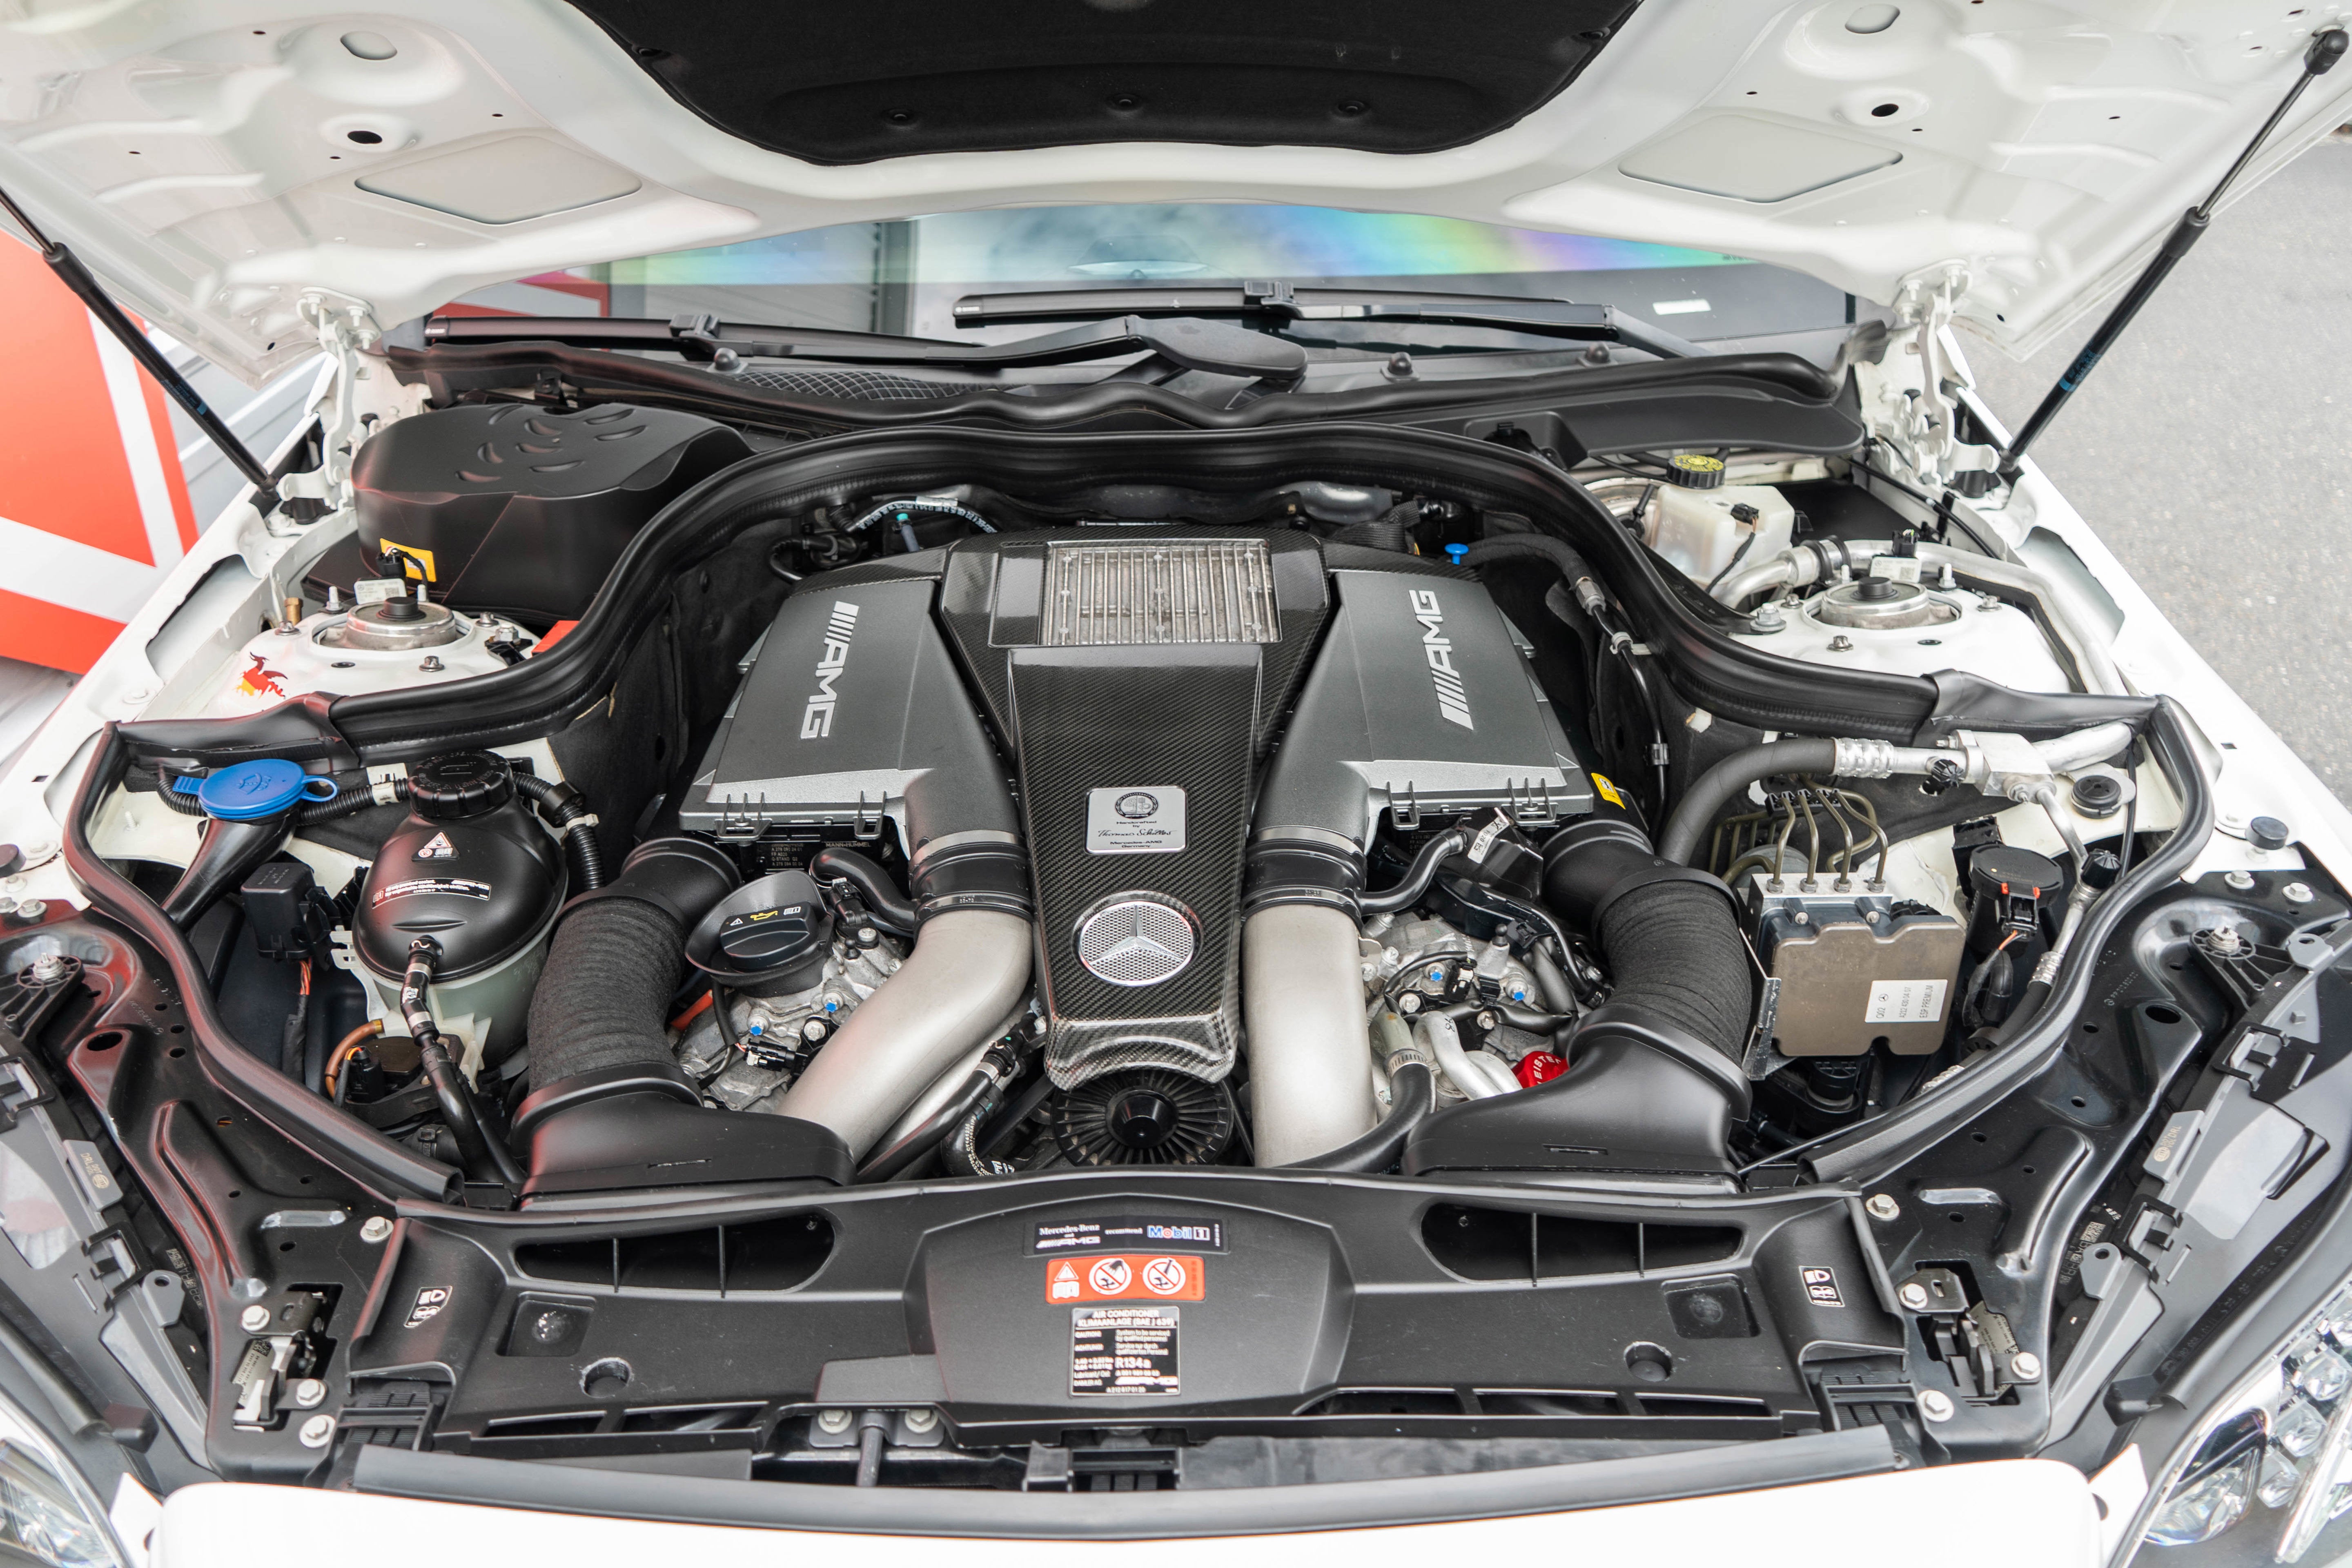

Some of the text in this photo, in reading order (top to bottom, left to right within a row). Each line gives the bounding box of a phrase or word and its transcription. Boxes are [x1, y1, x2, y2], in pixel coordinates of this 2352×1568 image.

[1409, 590, 1462, 686] AMG
[800, 635, 851, 739] AMG
[1922, 984, 1933, 1008] PREMIUM
[80, 1152, 94, 1166] DRL
[1039, 1224, 1100, 1235] Mercedes-Benz
[1147, 1225, 1192, 1239] Mobil
[1056, 1236, 1100, 1247] AMG
[1092, 1310, 1160, 1319] AIR CONDITIONER
[1077, 1318, 1132, 1327] KLIMAANLAGE
[1133, 1318, 1151, 1326] (SAE
[1156, 1318, 1175, 1326] 639)
[1115, 1356, 1152, 1369] R134a
